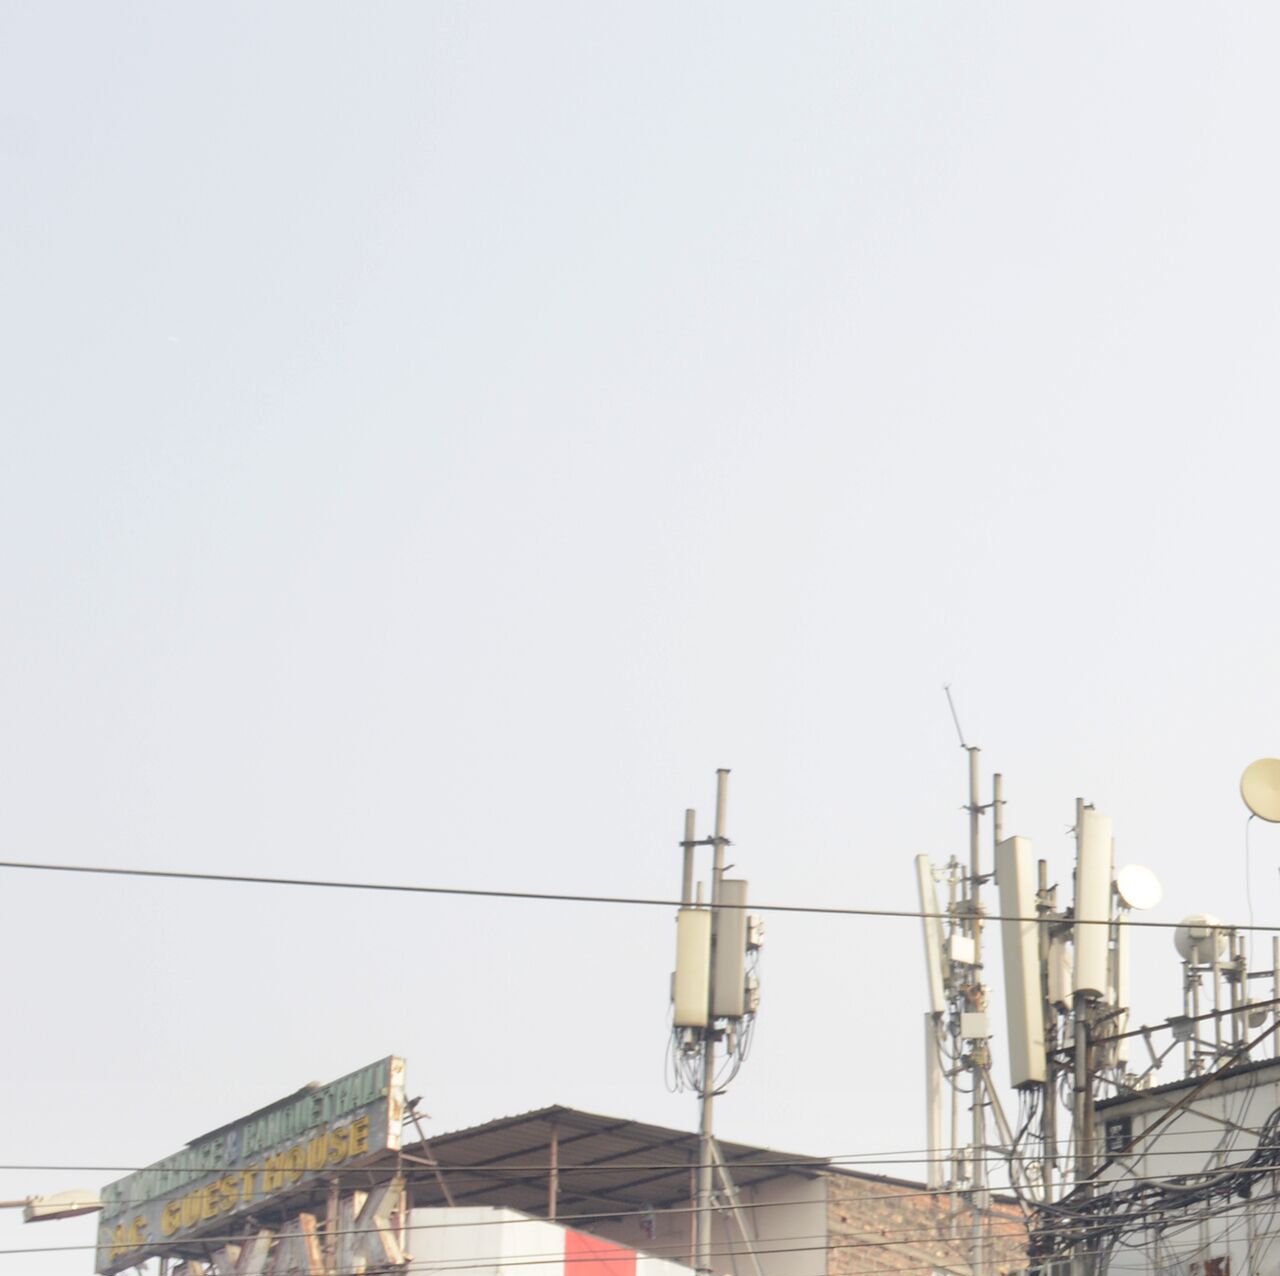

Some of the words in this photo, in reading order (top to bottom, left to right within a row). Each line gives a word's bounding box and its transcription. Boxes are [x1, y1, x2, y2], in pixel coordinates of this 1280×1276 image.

[242, 1089, 335, 1158] BANQUET
[161, 1161, 260, 1237] GUEST
[262, 1114, 370, 1194] HOUSE
